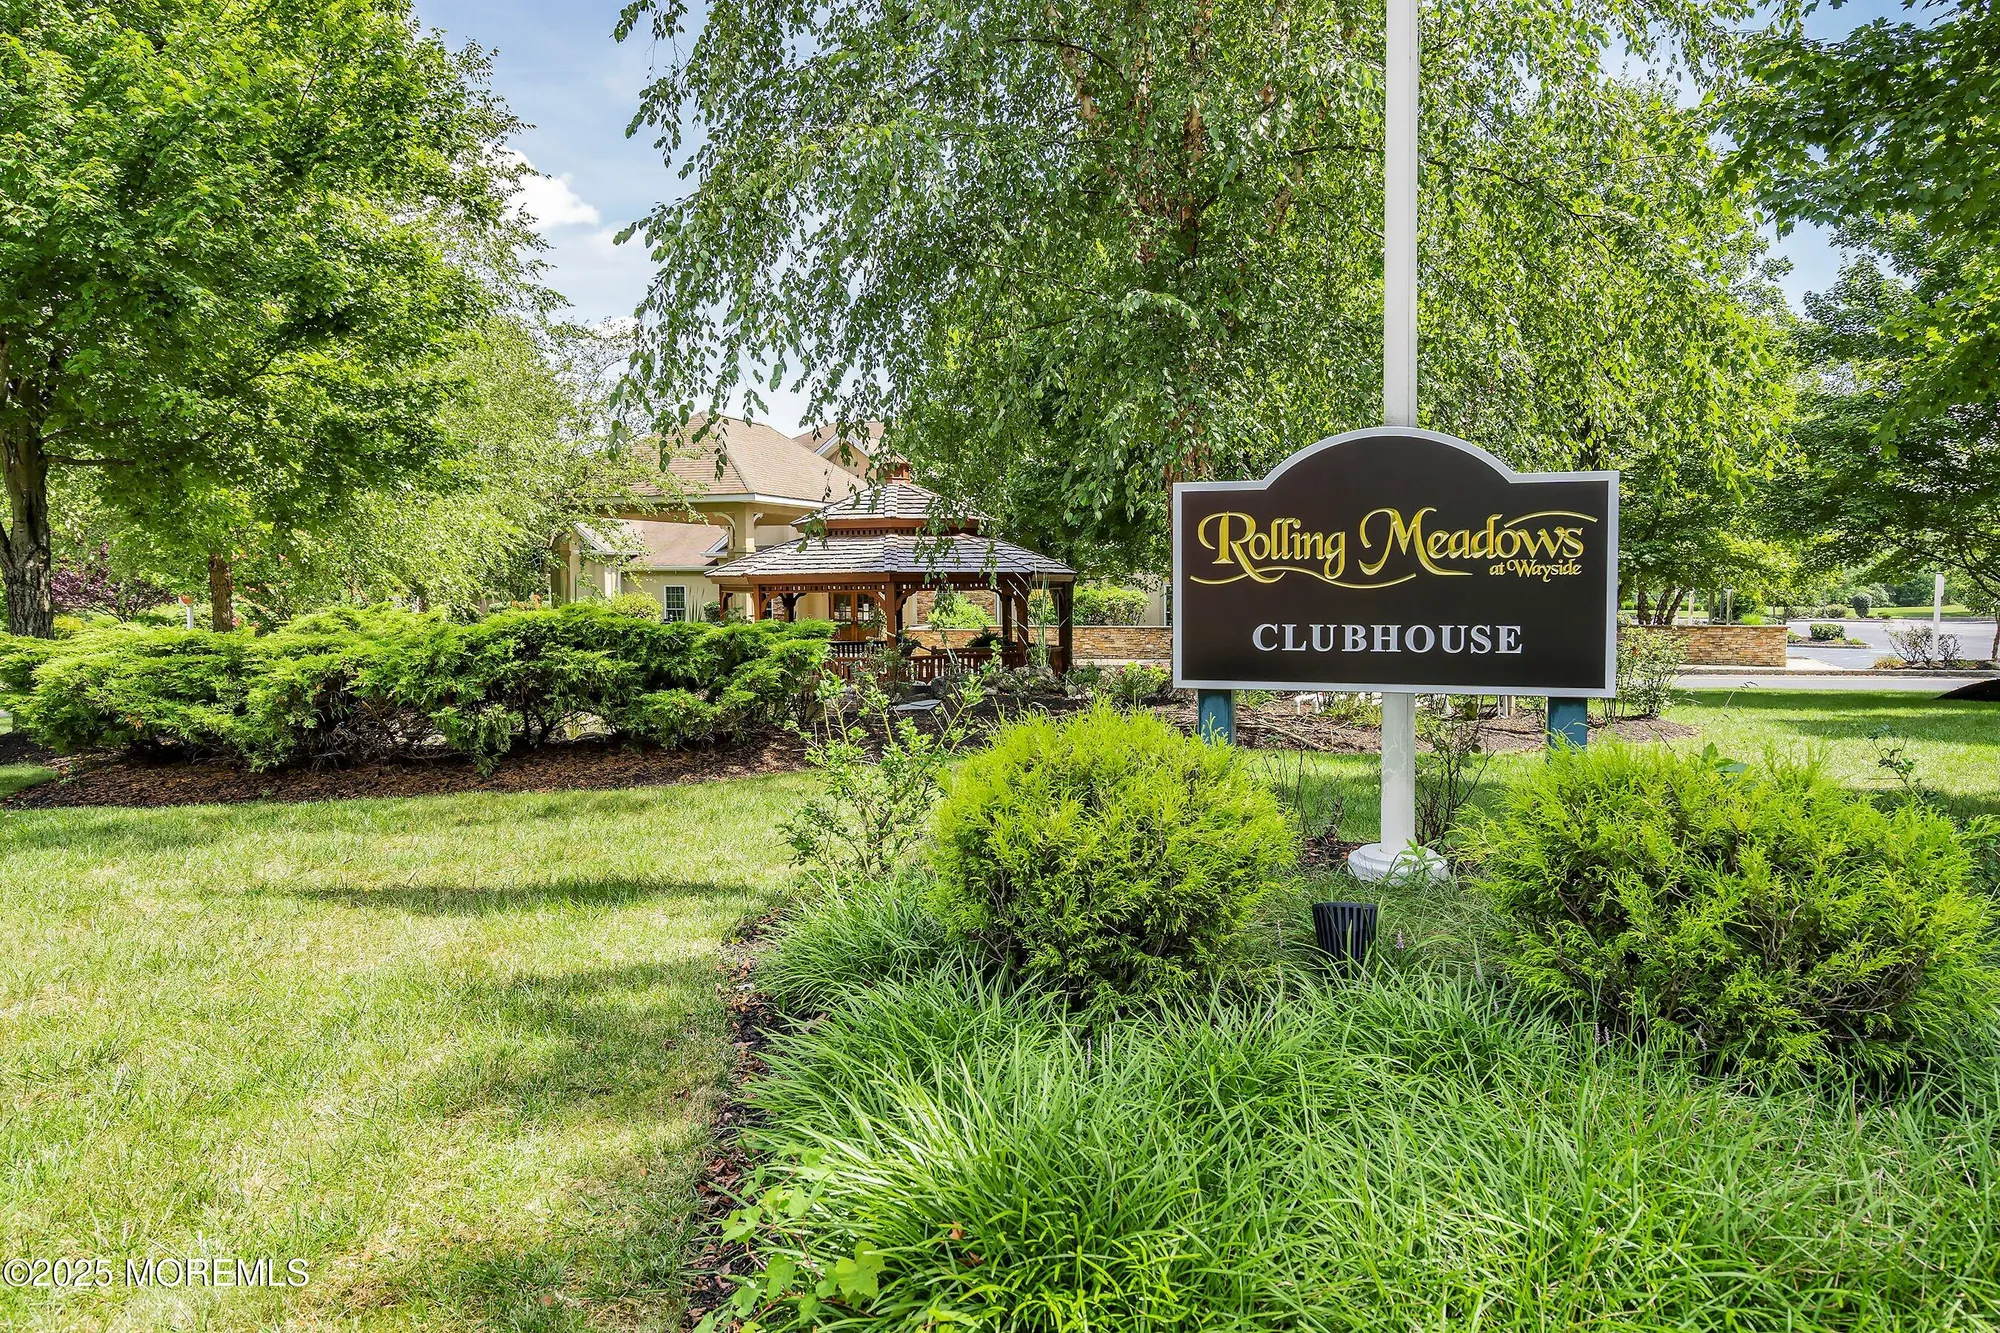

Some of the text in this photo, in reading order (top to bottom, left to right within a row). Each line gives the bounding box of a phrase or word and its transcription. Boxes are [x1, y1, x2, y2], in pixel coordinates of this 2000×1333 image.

[1197, 507, 1585, 583] Rolling Meadows
[1489, 559, 1582, 582] at Wayside
[1252, 623, 1524, 655] CLUBHOUSE
